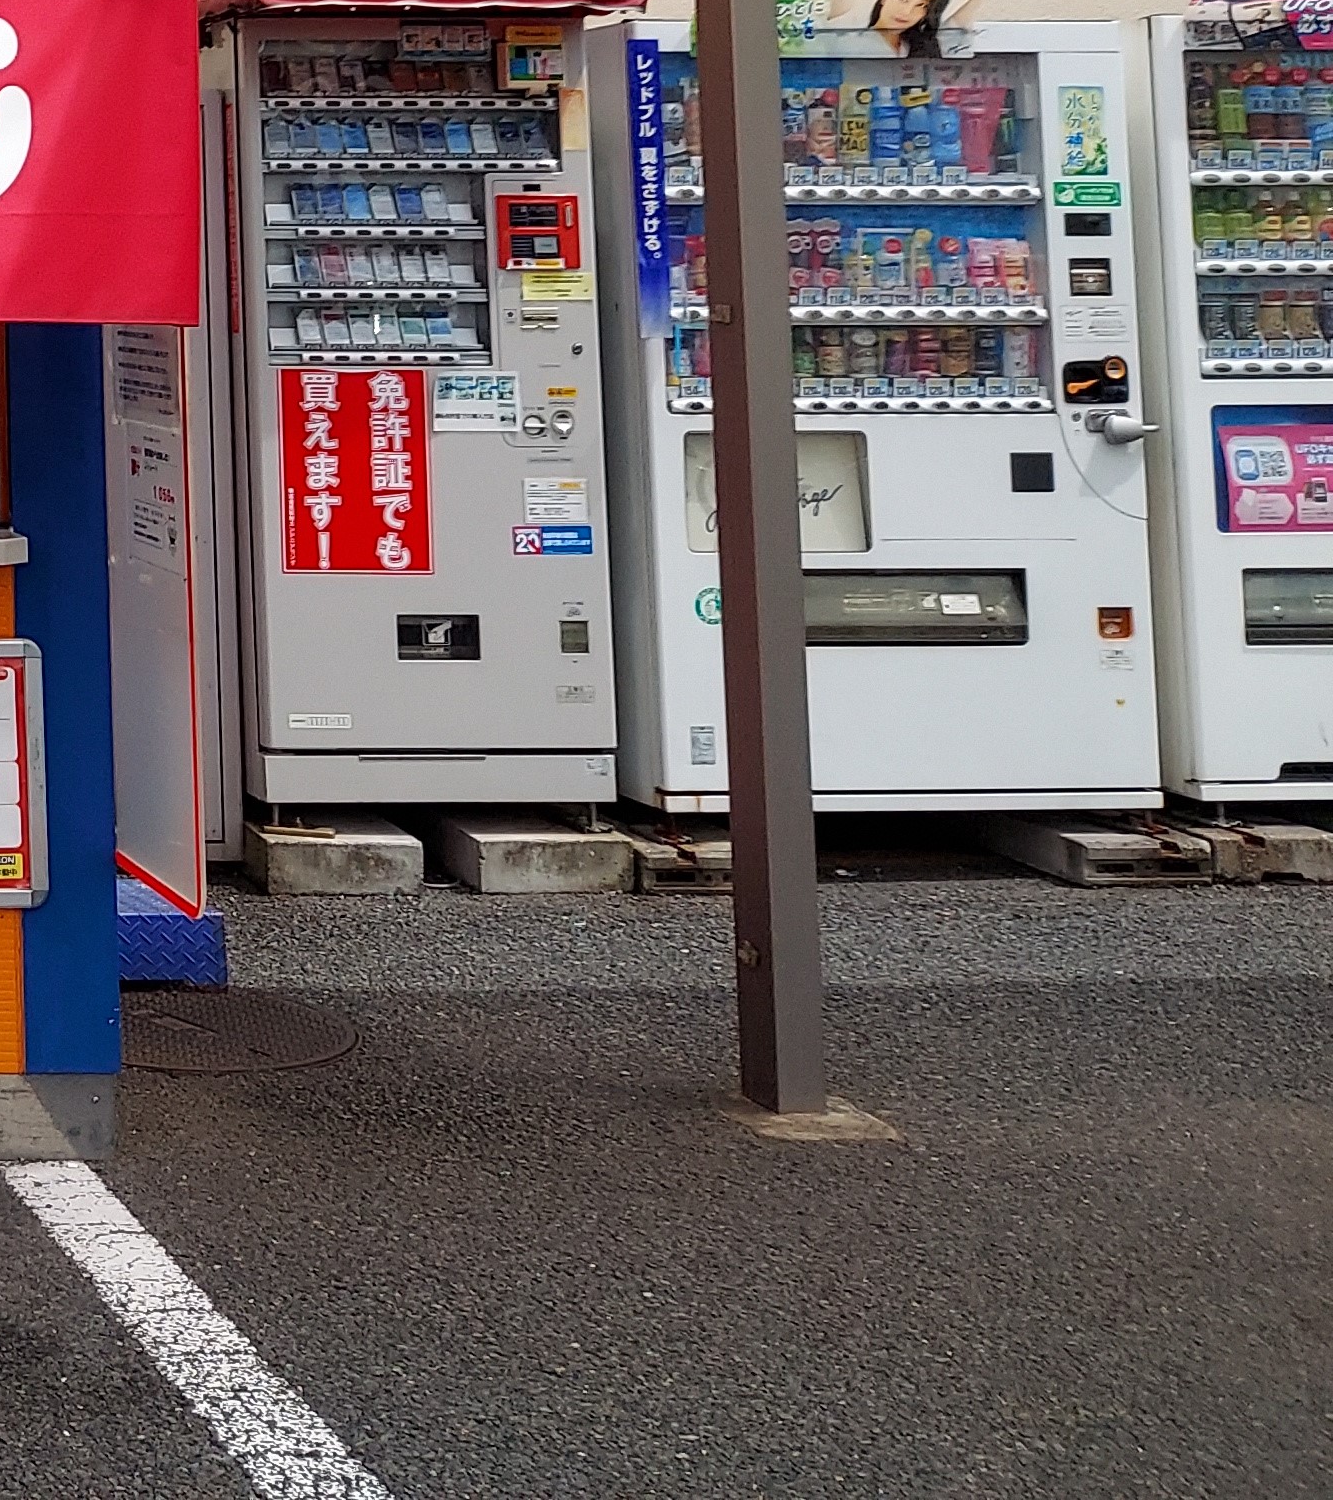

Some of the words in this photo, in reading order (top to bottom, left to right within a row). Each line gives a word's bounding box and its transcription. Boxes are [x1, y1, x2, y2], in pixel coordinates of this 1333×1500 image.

[636, 54, 657, 138] レッドブル
[299, 372, 342, 570] 買えます!
[368, 371, 413, 571] 免許証でも
